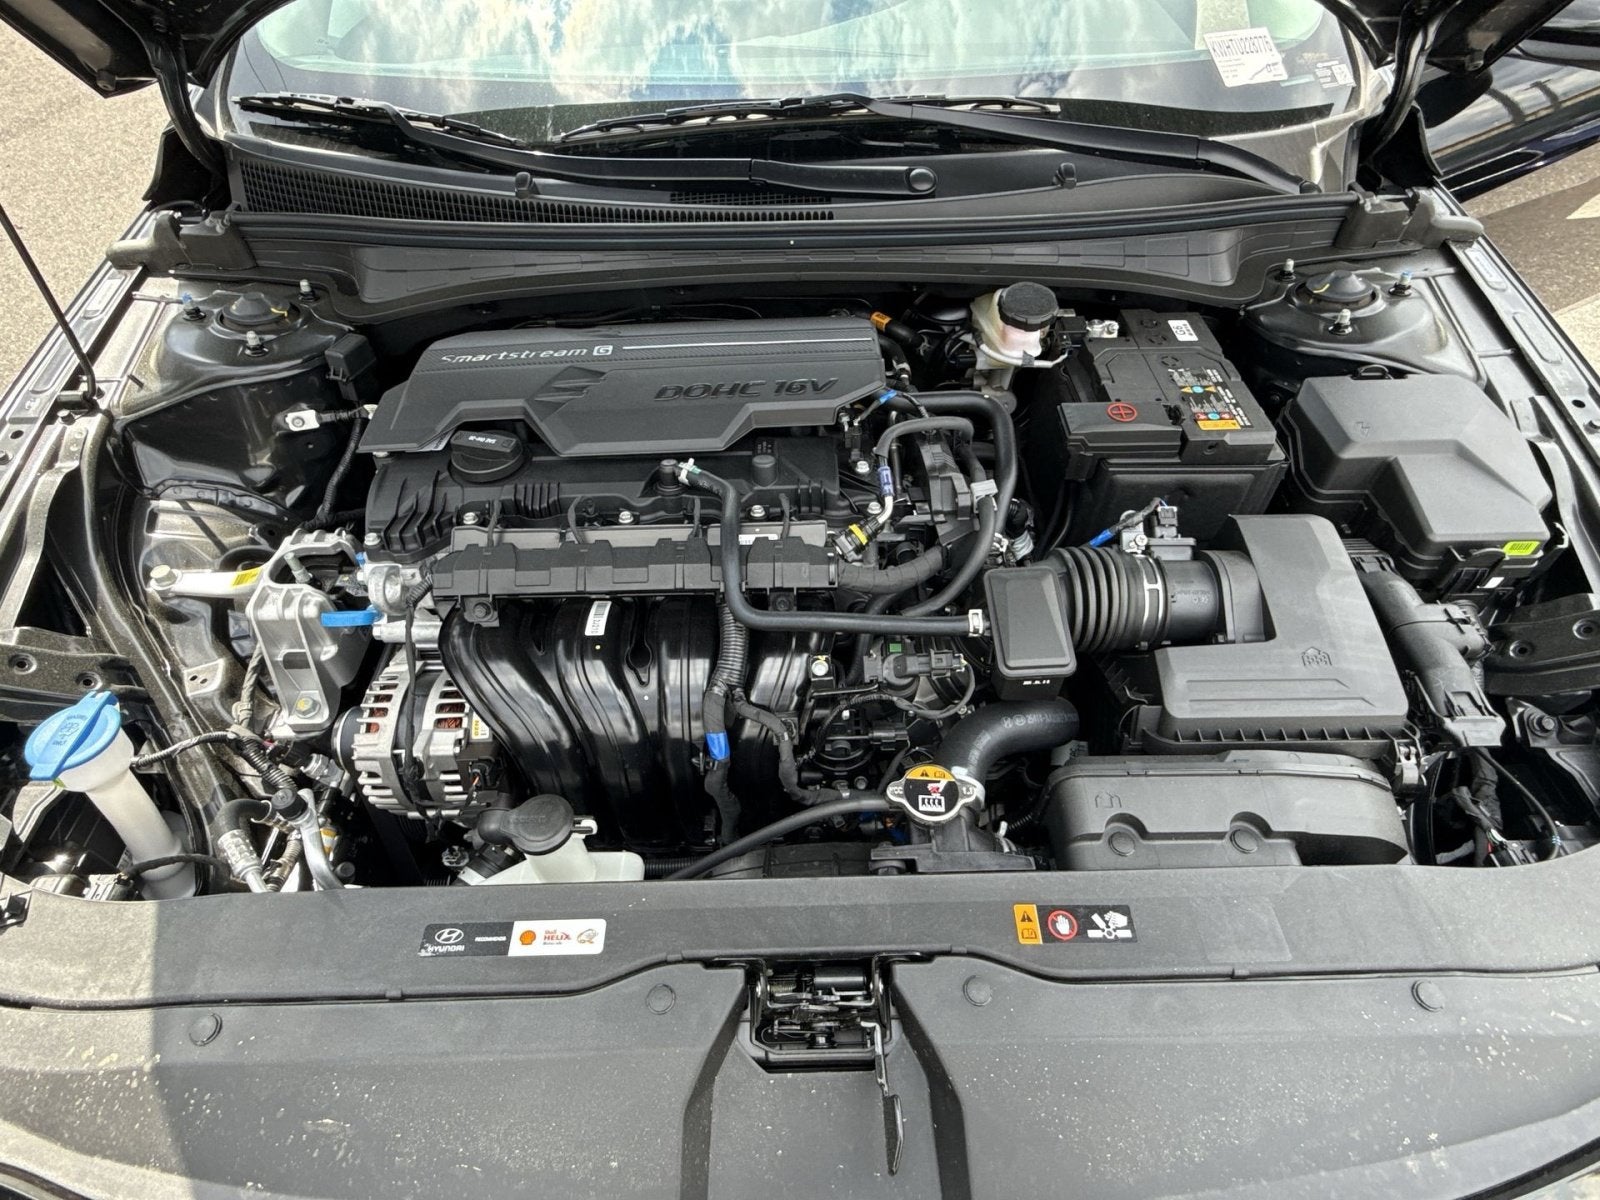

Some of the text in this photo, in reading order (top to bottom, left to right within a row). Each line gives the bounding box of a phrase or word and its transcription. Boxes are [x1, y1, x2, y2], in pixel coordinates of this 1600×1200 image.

[654, 377, 839, 401] DOHC 16V
[543, 932, 571, 941] HELIX
[427, 944, 465, 953] HYUNDAI
